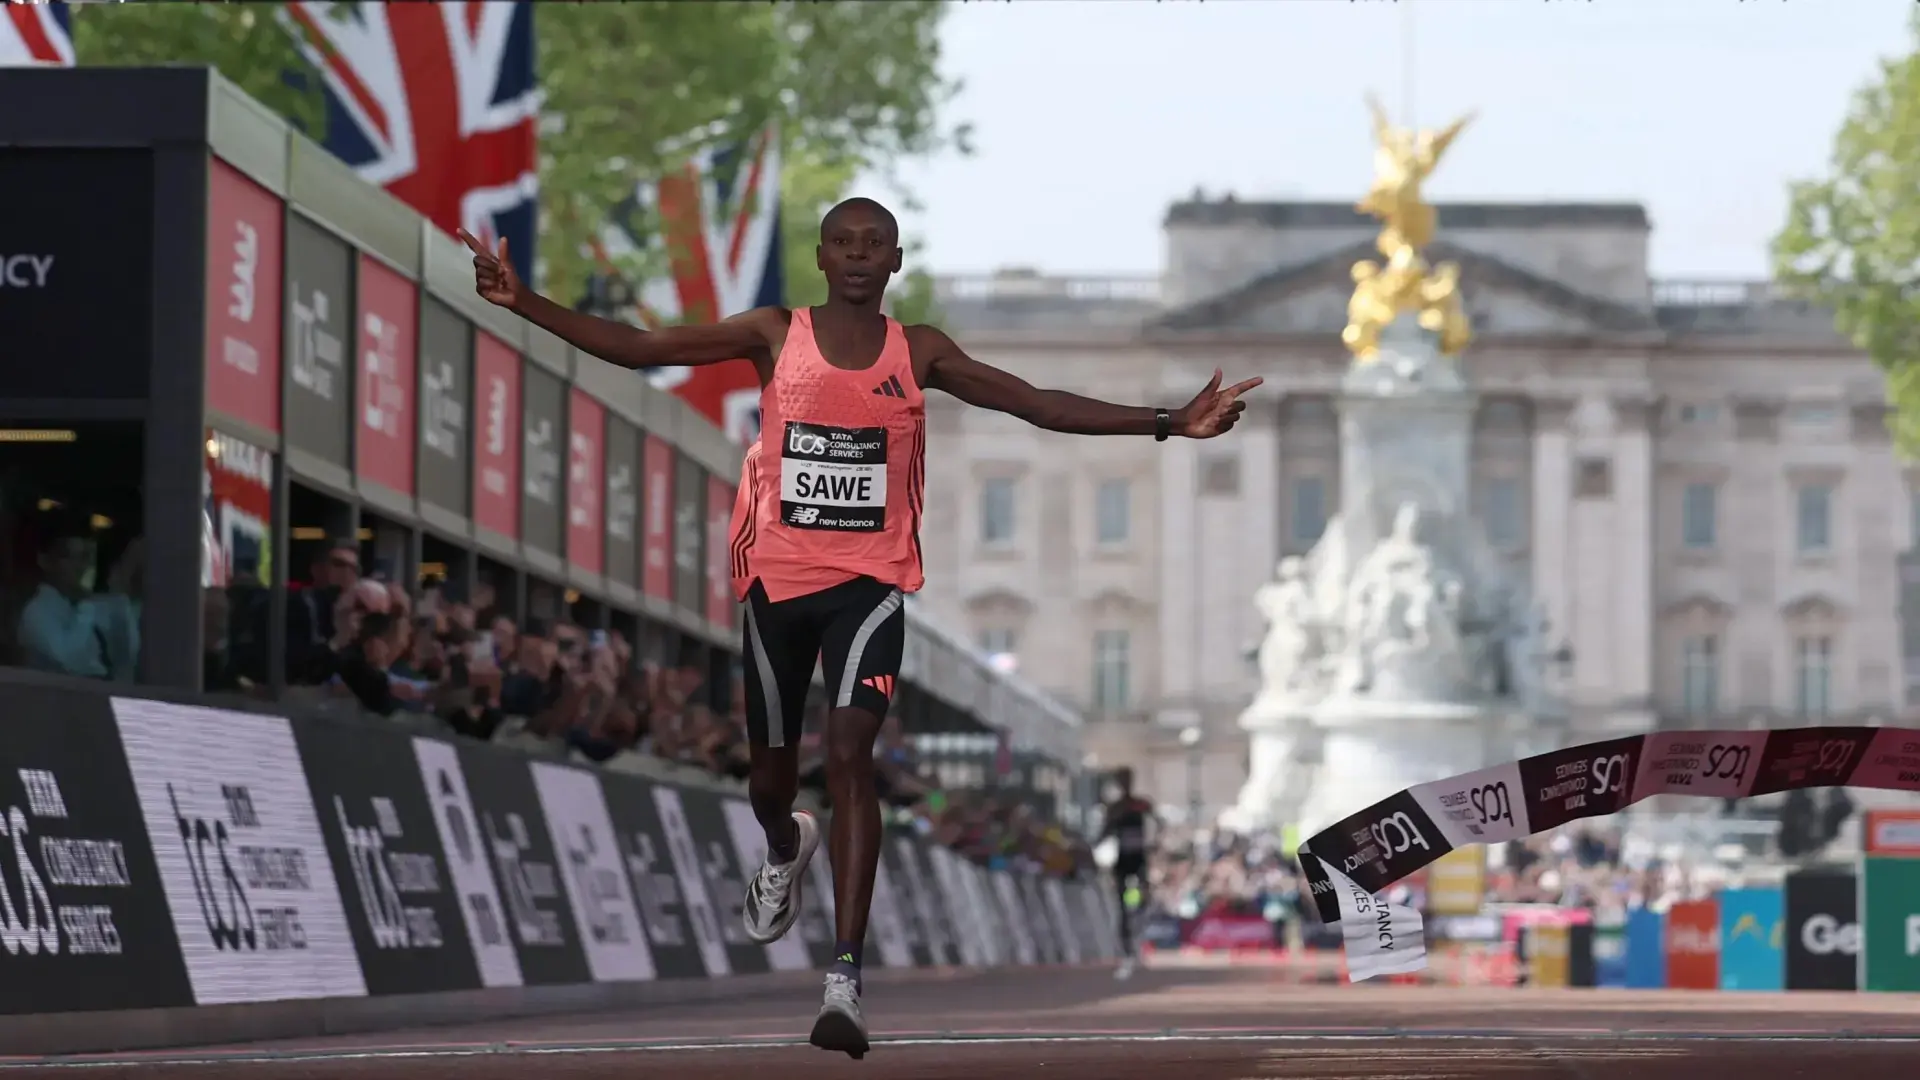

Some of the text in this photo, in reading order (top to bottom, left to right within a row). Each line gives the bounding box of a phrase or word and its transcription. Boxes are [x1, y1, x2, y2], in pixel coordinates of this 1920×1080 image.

[0, 254, 55, 287] CY
[789, 428, 826, 455] tcs
[829, 441, 881, 450] CONSULTANCY
[830, 432, 853, 441] TATA
[829, 449, 864, 458] SERVICES
[795, 471, 872, 501] SAWE
[819, 518, 875, 527] new balance
[1702, 744, 1751, 787] tcs
[1470, 781, 1514, 827] tcs
[1371, 811, 1430, 859] tcs
[0, 804, 59, 955] cs
[166, 781, 257, 951] tcs
